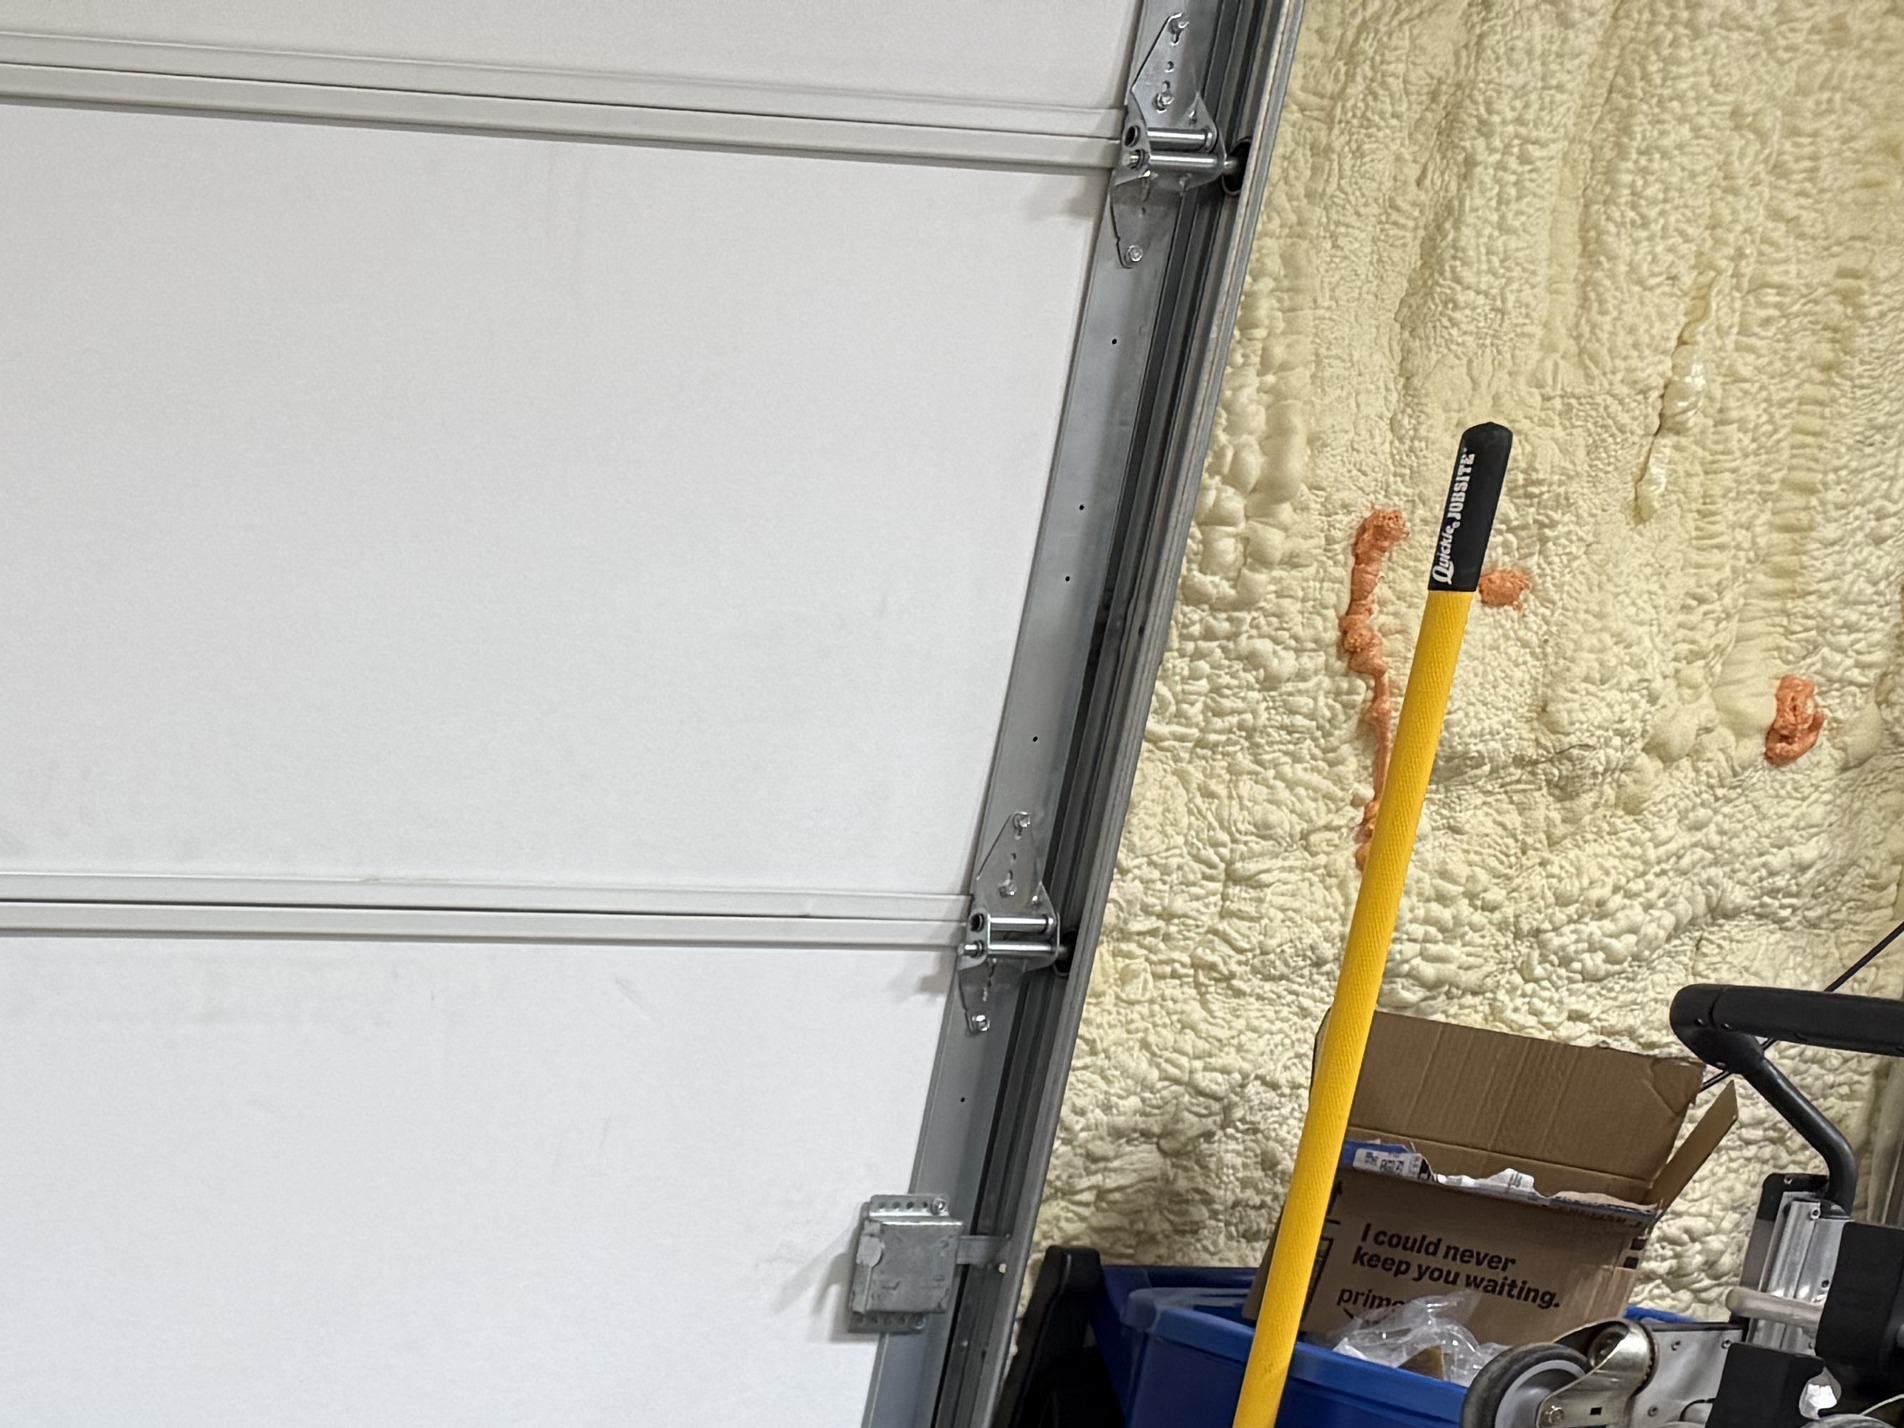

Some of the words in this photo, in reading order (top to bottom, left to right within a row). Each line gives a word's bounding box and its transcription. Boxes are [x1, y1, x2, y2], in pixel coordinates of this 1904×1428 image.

[1432, 525, 1455, 586] Quickie
[1447, 453, 1475, 520] JOBSITE
[1352, 1245, 1411, 1279] keep
[1413, 1261, 1459, 1287] you
[1465, 1274, 1561, 1310] waiting.
[1360, 1222, 1372, 1243] I
[1373, 1228, 1441, 1257] could
[1443, 1242, 1517, 1272] never
